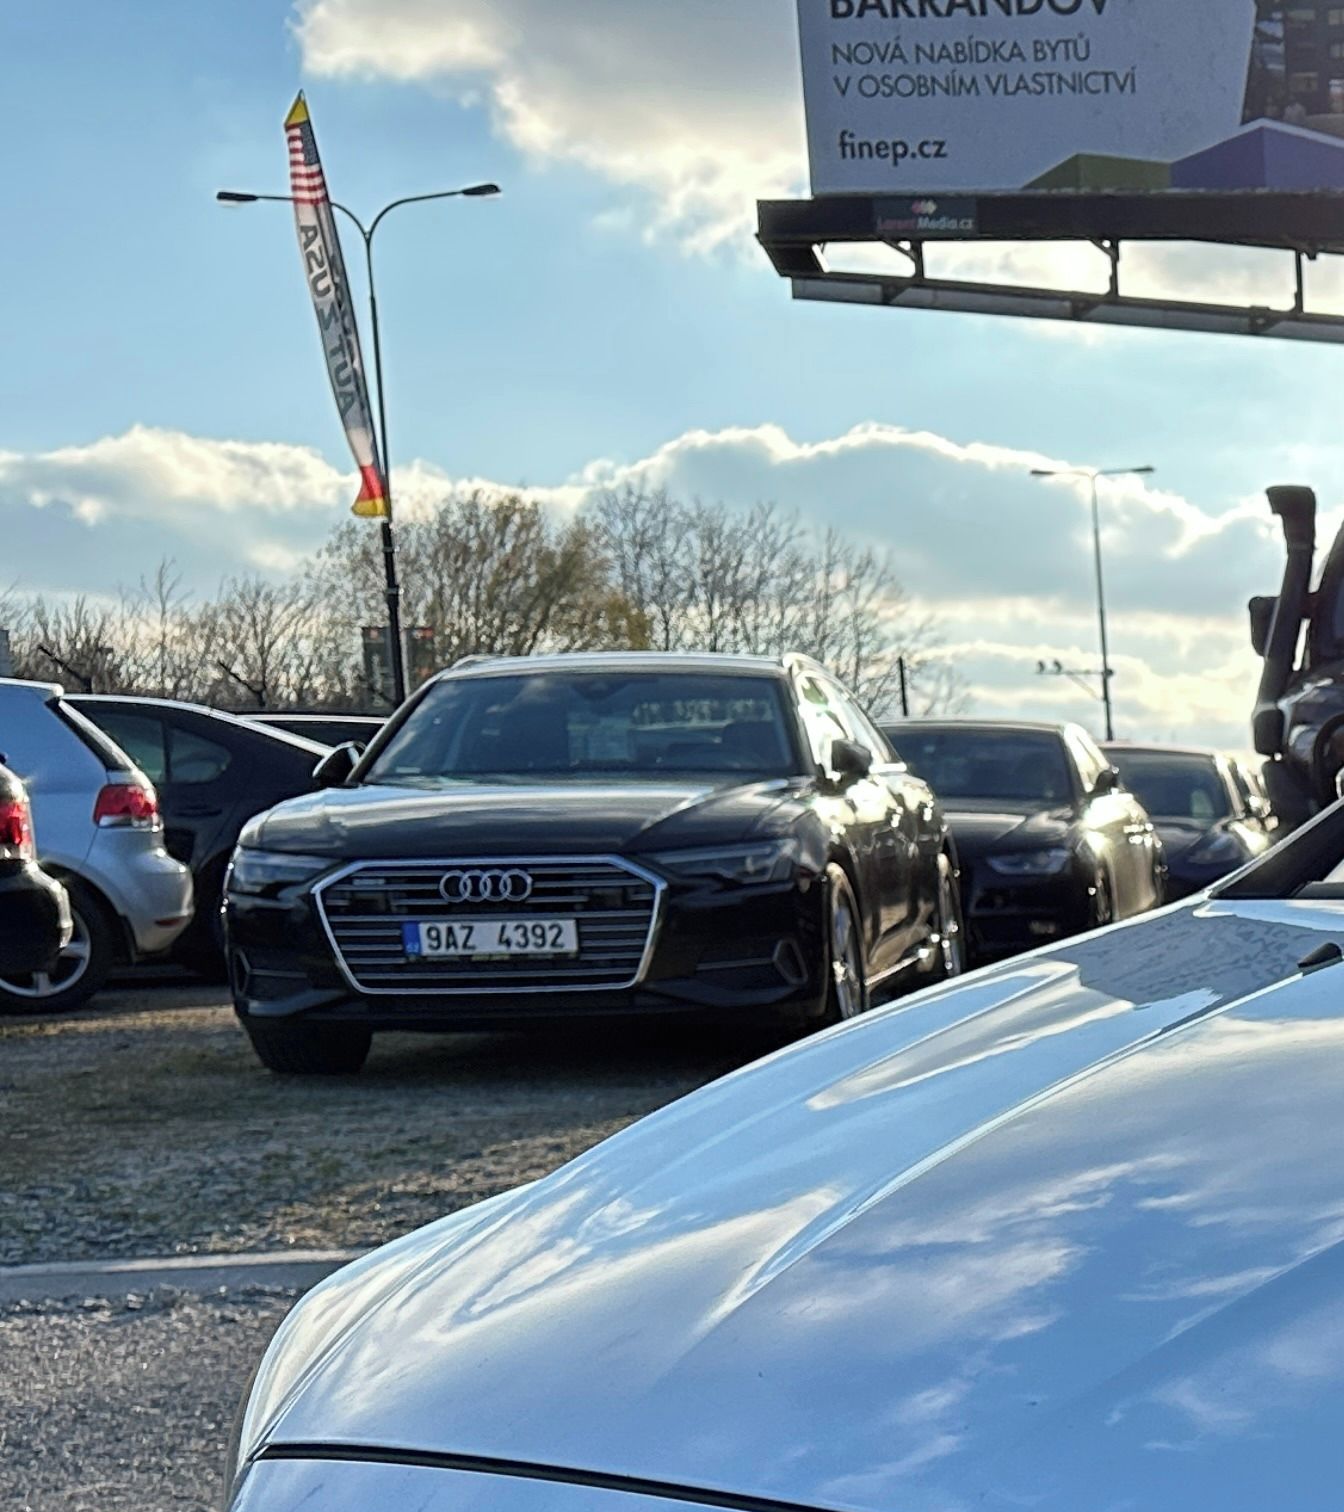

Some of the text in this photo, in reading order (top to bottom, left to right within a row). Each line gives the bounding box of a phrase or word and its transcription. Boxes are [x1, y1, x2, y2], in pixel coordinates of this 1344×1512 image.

[832, 33, 1090, 64] NOVÁ NABÍDKA BYTŮ
[834, 66, 1137, 97] V OSOBNÍM VLASTNICTVÍ
[839, 130, 948, 167] finep.cz
[426, 924, 565, 951] 9AZ 4392
